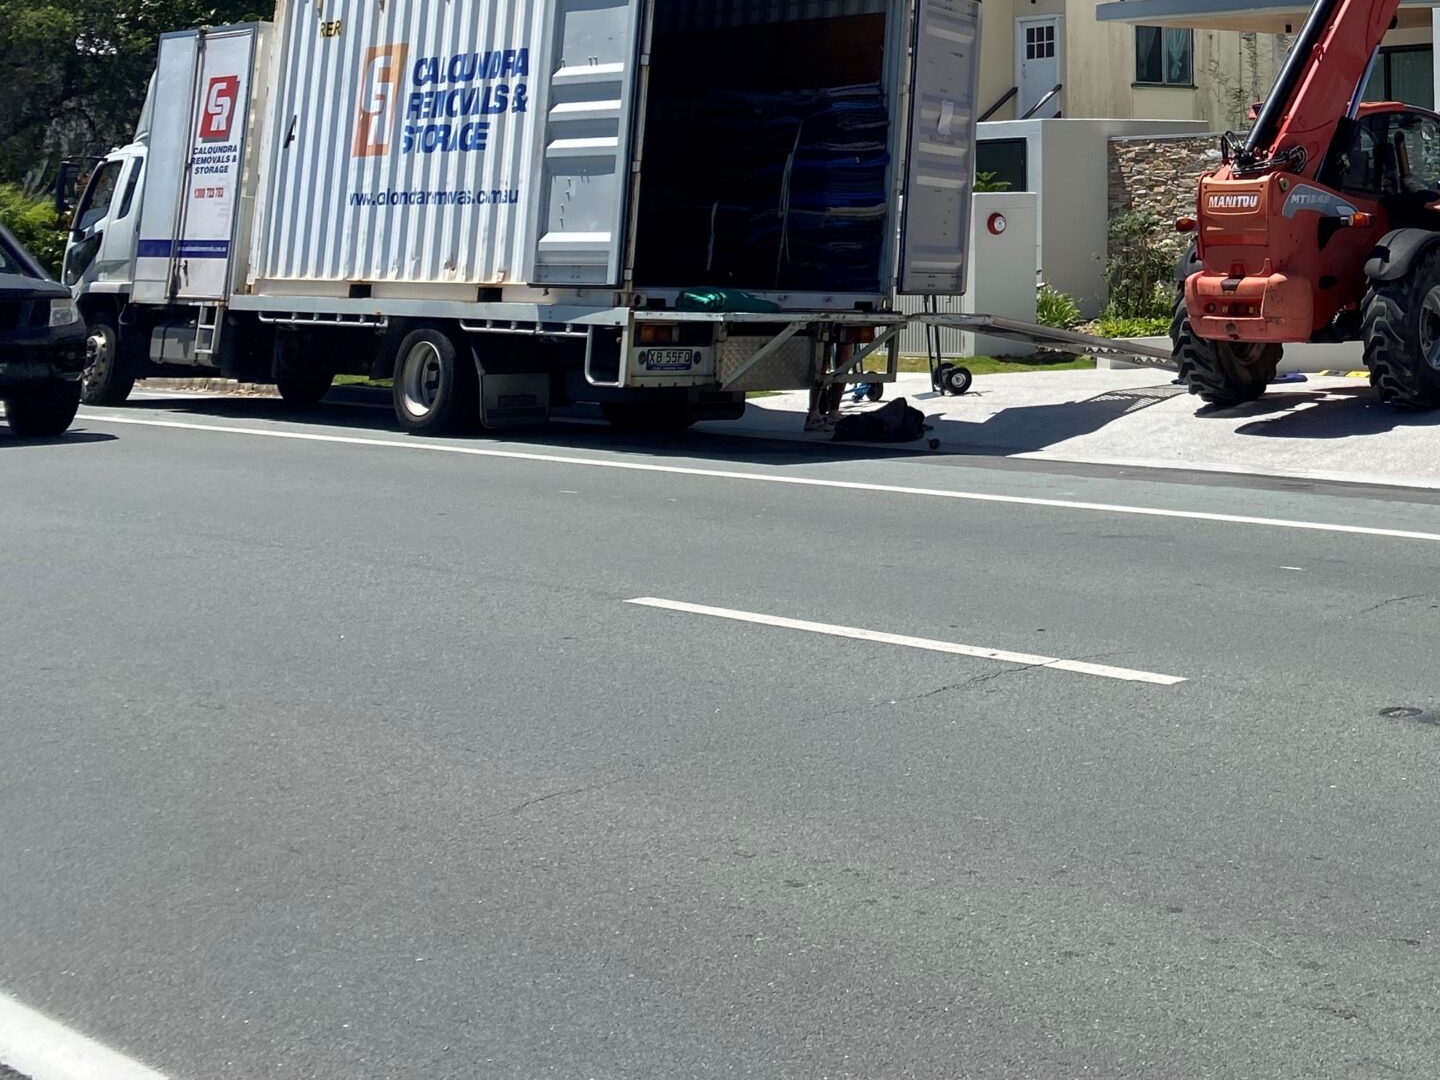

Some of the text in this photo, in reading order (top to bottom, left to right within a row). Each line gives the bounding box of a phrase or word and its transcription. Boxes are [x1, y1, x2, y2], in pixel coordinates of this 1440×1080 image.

[511, 83, 528, 113] &
[193, 145, 237, 155] CALOUNDRA
[191, 155, 230, 164] REMOVALS
[194, 166, 229, 175] STORAGE
[1208, 195, 1257, 208] MANITOU
